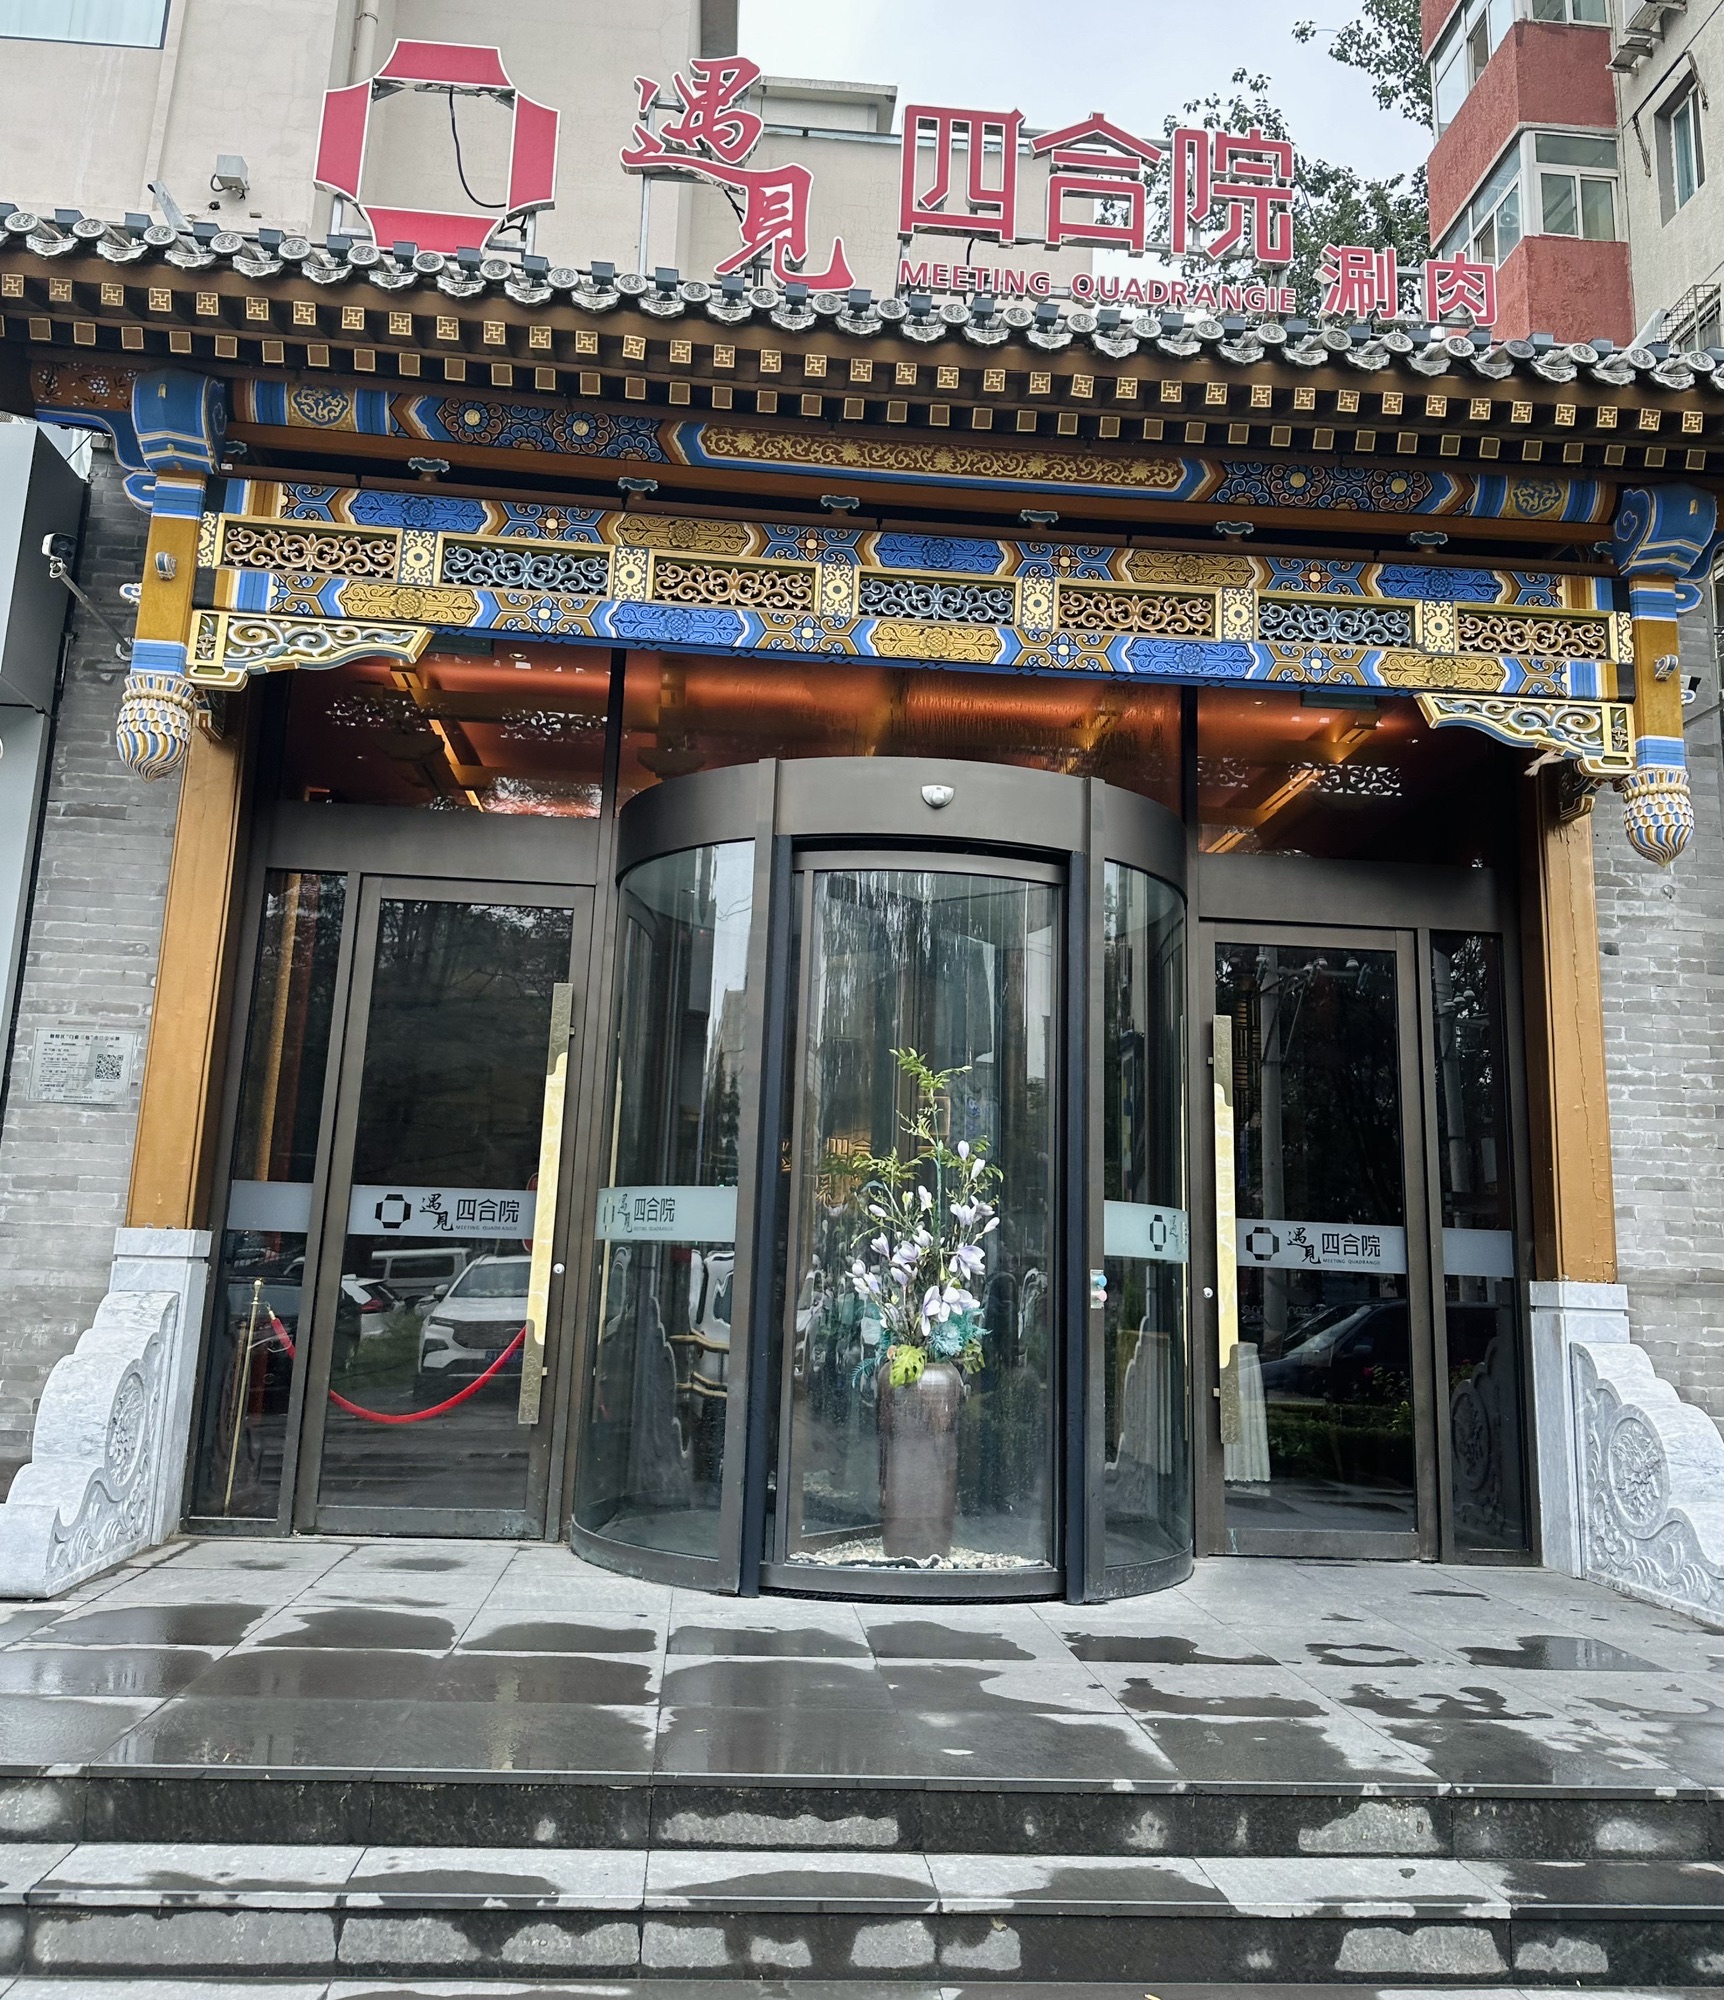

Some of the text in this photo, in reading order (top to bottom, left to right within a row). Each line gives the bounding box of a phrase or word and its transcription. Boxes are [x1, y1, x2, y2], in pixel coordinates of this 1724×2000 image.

[899, 104, 1295, 264] 四合院
[899, 260, 1051, 296] MEETING
[1319, 243, 1499, 327] 涮肉
[456, 1199, 520, 1223] 四合院
[635, 1198, 676, 1222] 四合院
[1322, 1233, 1381, 1257] 四合院
